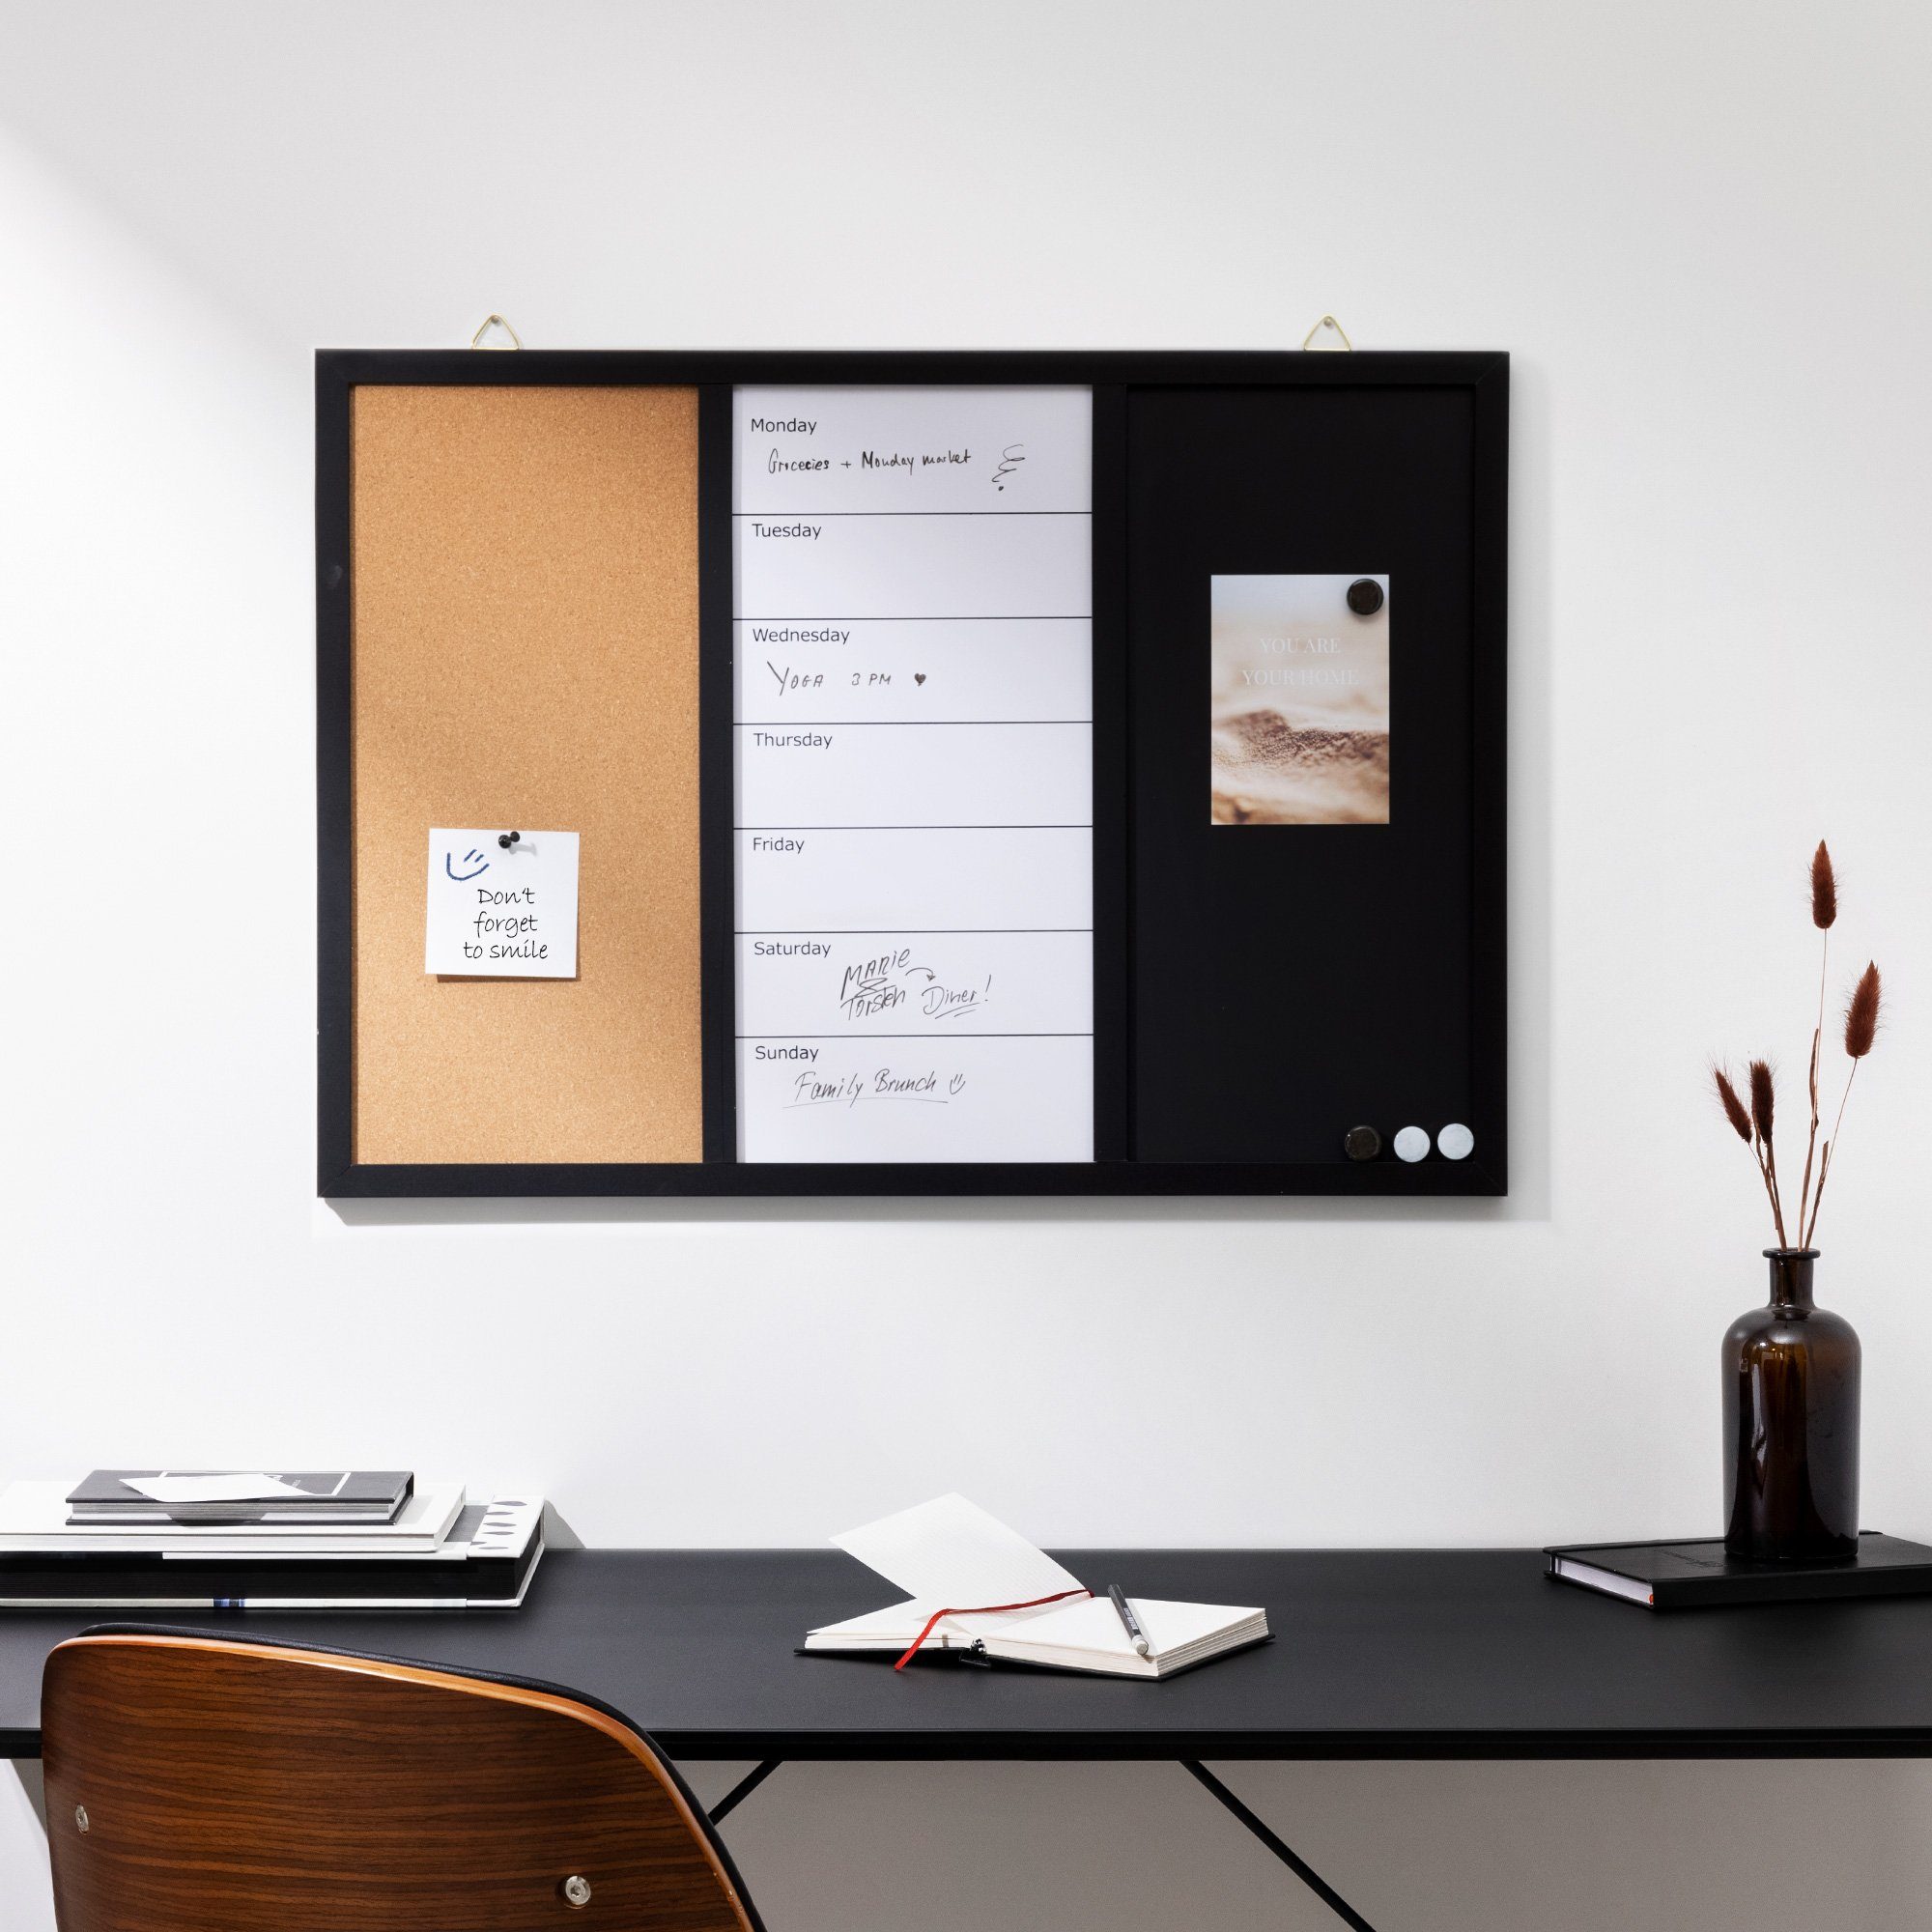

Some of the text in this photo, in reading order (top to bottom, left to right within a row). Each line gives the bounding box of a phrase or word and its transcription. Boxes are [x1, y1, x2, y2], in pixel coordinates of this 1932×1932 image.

[751, 417, 817, 435] Monday
[923, 449, 972, 465] market
[752, 524, 822, 540] Tuesday
[753, 629, 850, 645] Wednesday
[1260, 638, 1341, 653] YOU ARE
[851, 672, 861, 687] 3
[868, 673, 892, 687] PM
[1242, 669, 1359, 686] YOUR HOME
[753, 733, 833, 750] Thursday
[753, 838, 805, 854] Friday
[473, 911, 538, 938] forget
[464, 939, 548, 959] to smile
[754, 942, 832, 958] Saturday
[755, 1045, 819, 1063] Sunday
[794, 1068, 936, 1108] Family Brunch
